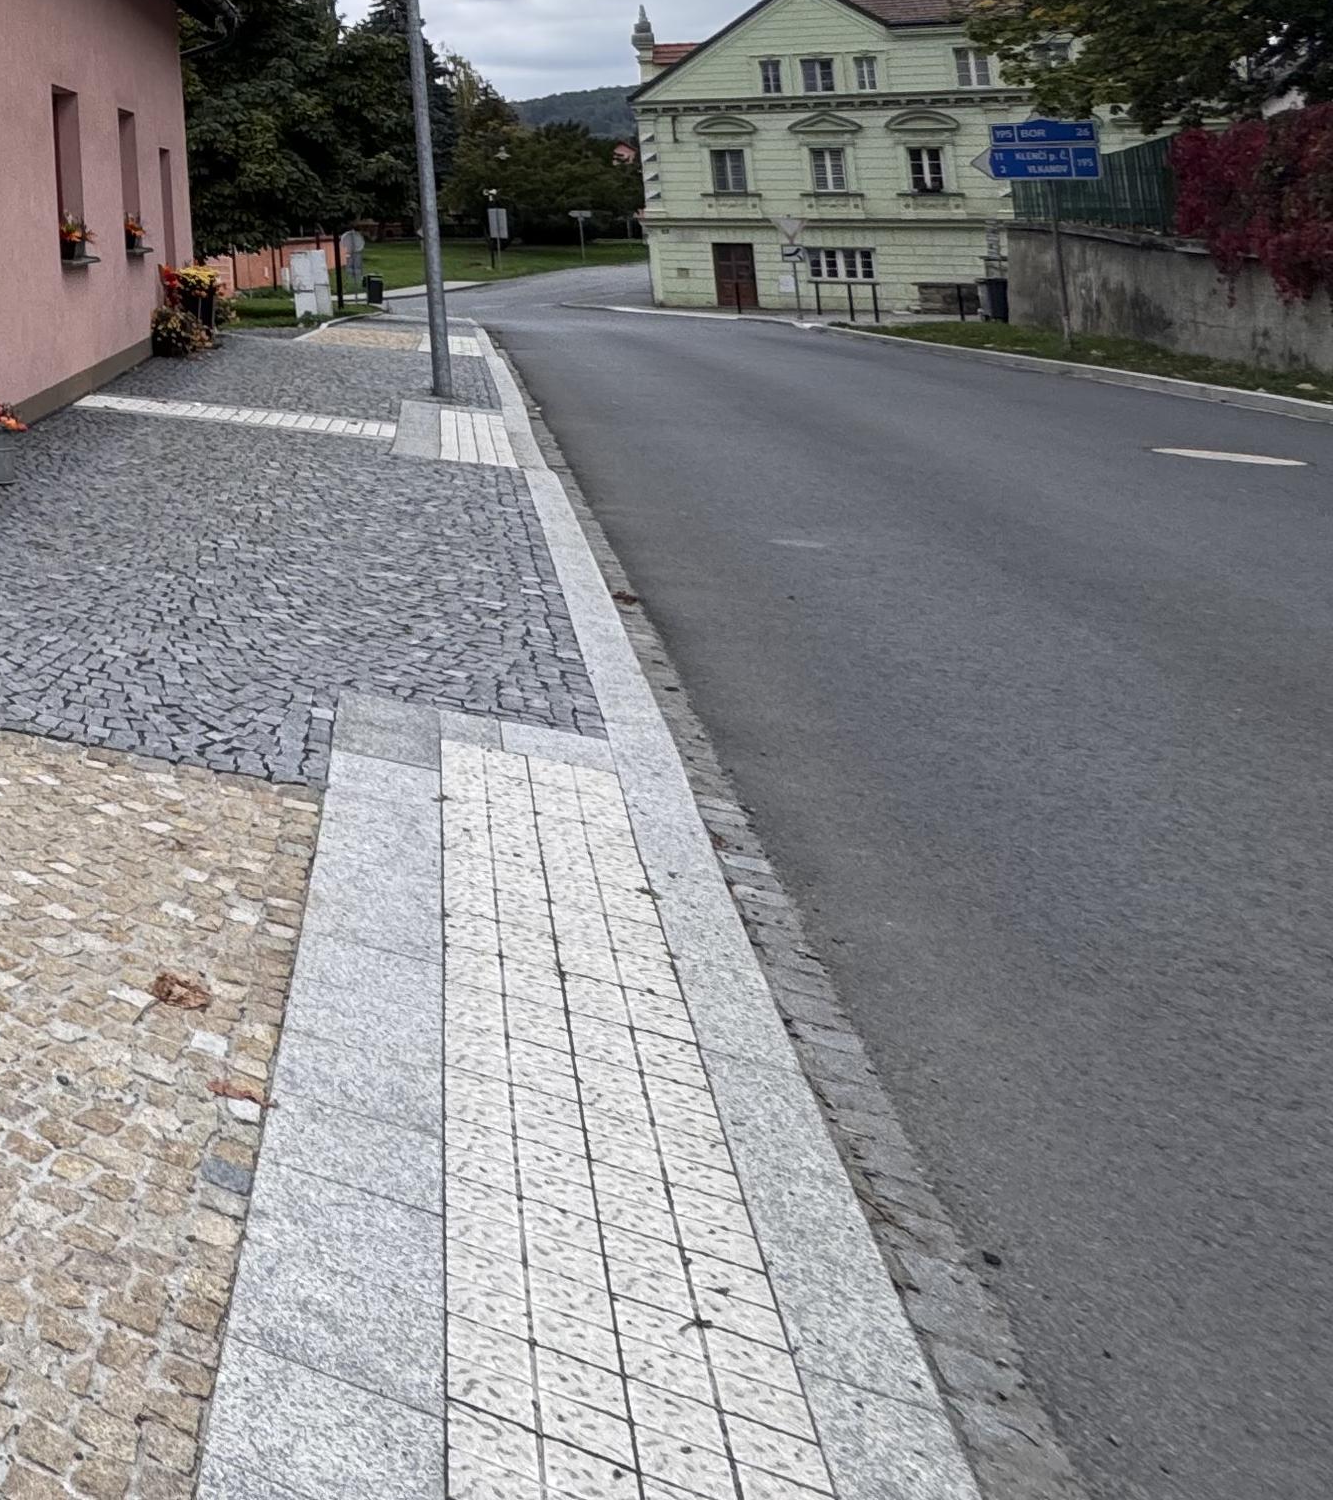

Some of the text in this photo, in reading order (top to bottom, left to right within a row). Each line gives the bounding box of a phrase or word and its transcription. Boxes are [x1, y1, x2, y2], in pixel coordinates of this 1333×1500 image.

[995, 129, 1014, 139] 195
[1020, 127, 1091, 138] BOR 26
